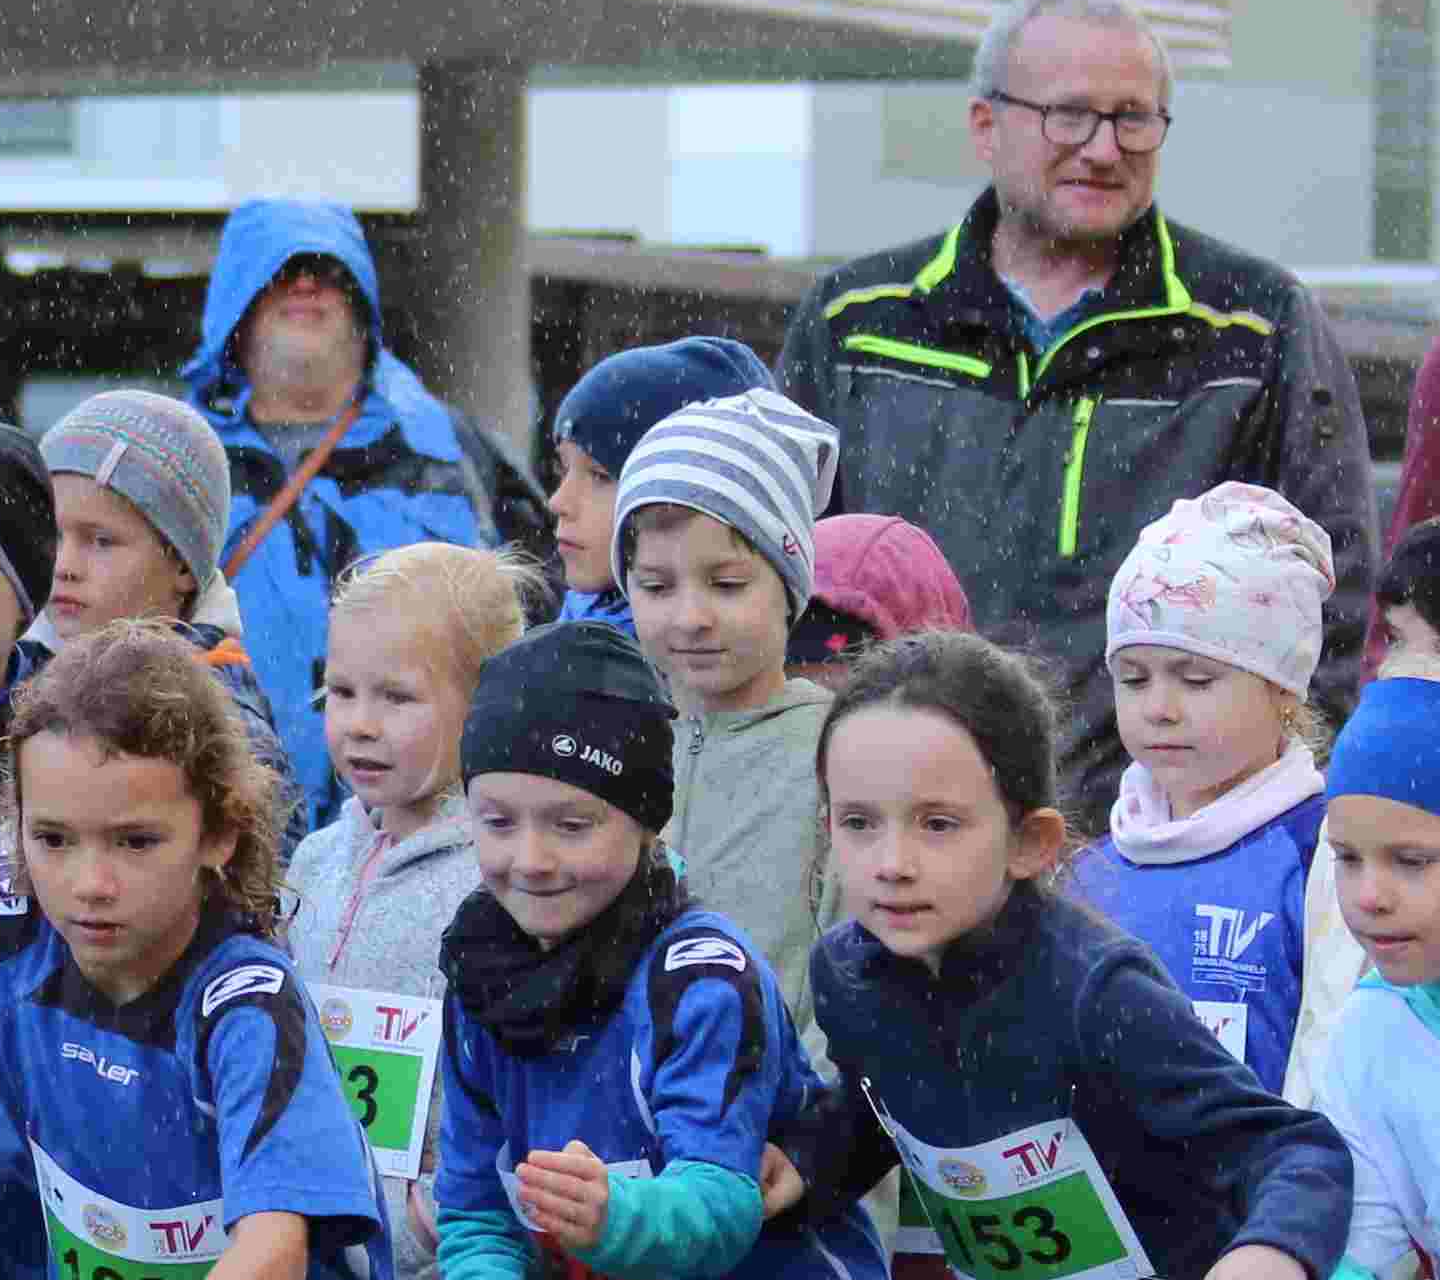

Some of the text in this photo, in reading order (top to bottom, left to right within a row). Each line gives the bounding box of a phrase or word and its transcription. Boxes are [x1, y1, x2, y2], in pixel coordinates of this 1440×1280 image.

[579, 745, 624, 776] JAKO
[1195, 904, 1275, 960] TV
[1001, 1132, 1065, 1177] TV
[150, 1216, 214, 1254] TV
[942, 1206, 1072, 1271] 153
